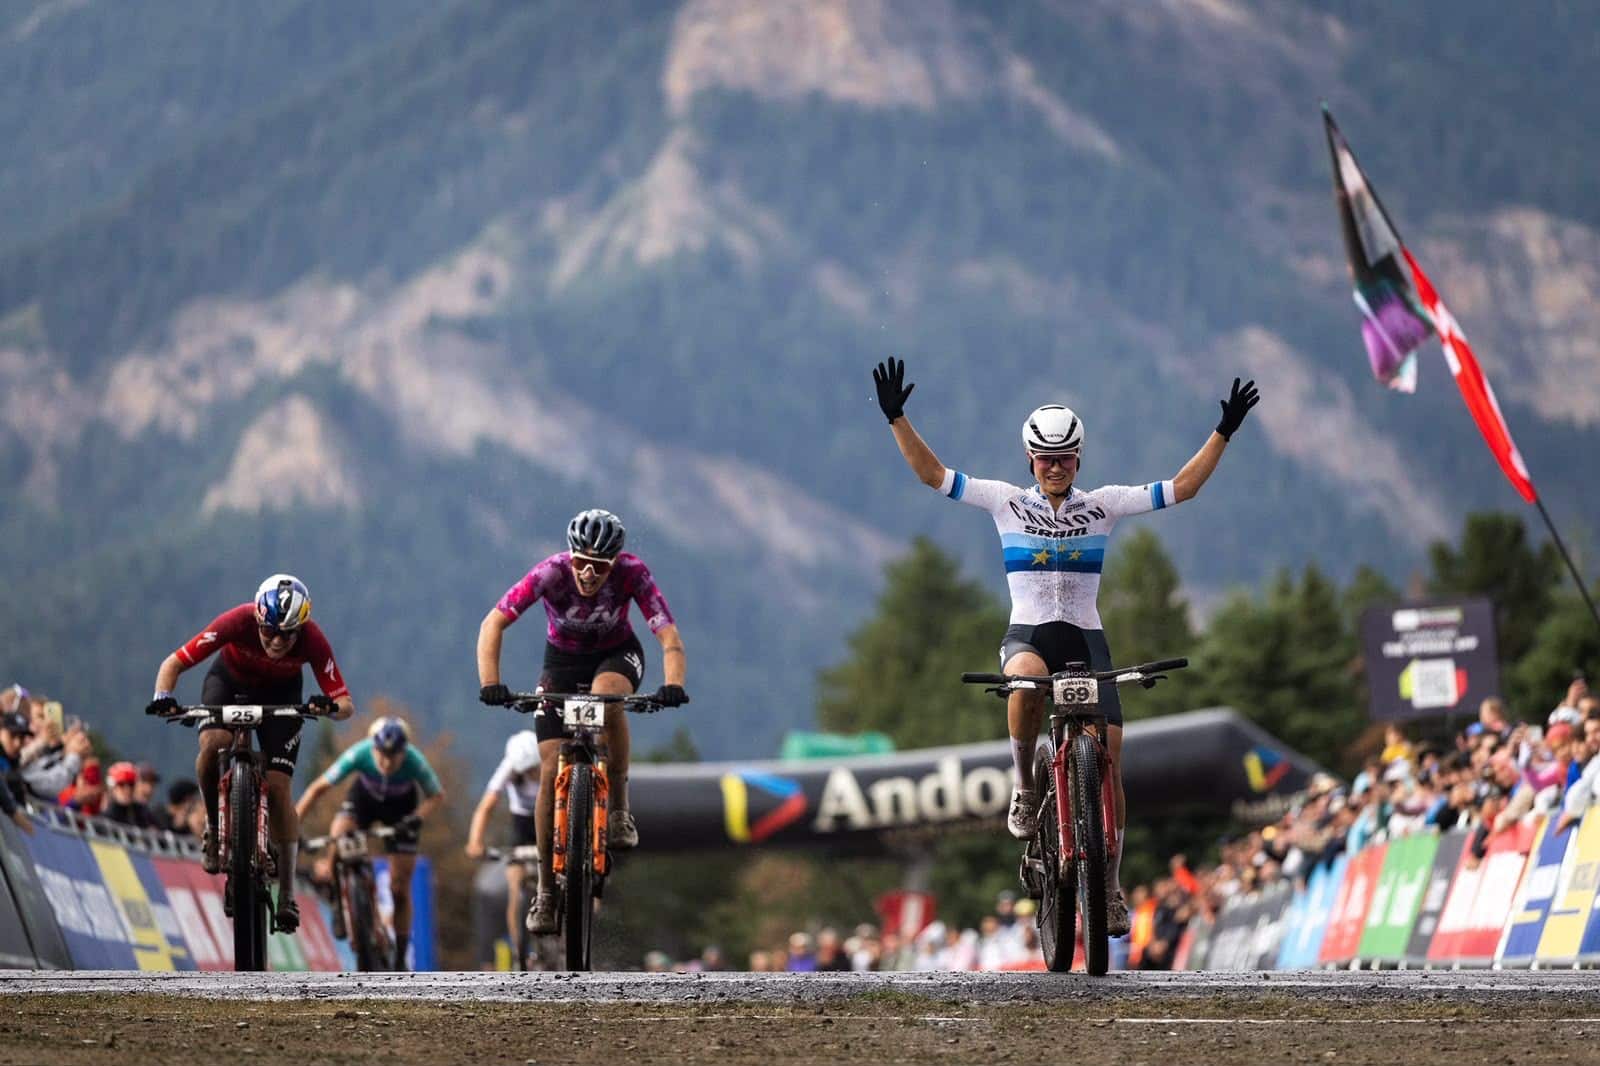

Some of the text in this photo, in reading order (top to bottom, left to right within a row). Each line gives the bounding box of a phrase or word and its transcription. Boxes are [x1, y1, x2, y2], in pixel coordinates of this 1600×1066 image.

[1009, 500, 1107, 530] CANYON
[1024, 525, 1089, 538] SRAM
[1063, 687, 1090, 702] 69
[231, 710, 255, 722] 25
[572, 705, 597, 721] 14
[814, 754, 1015, 833] Ando
